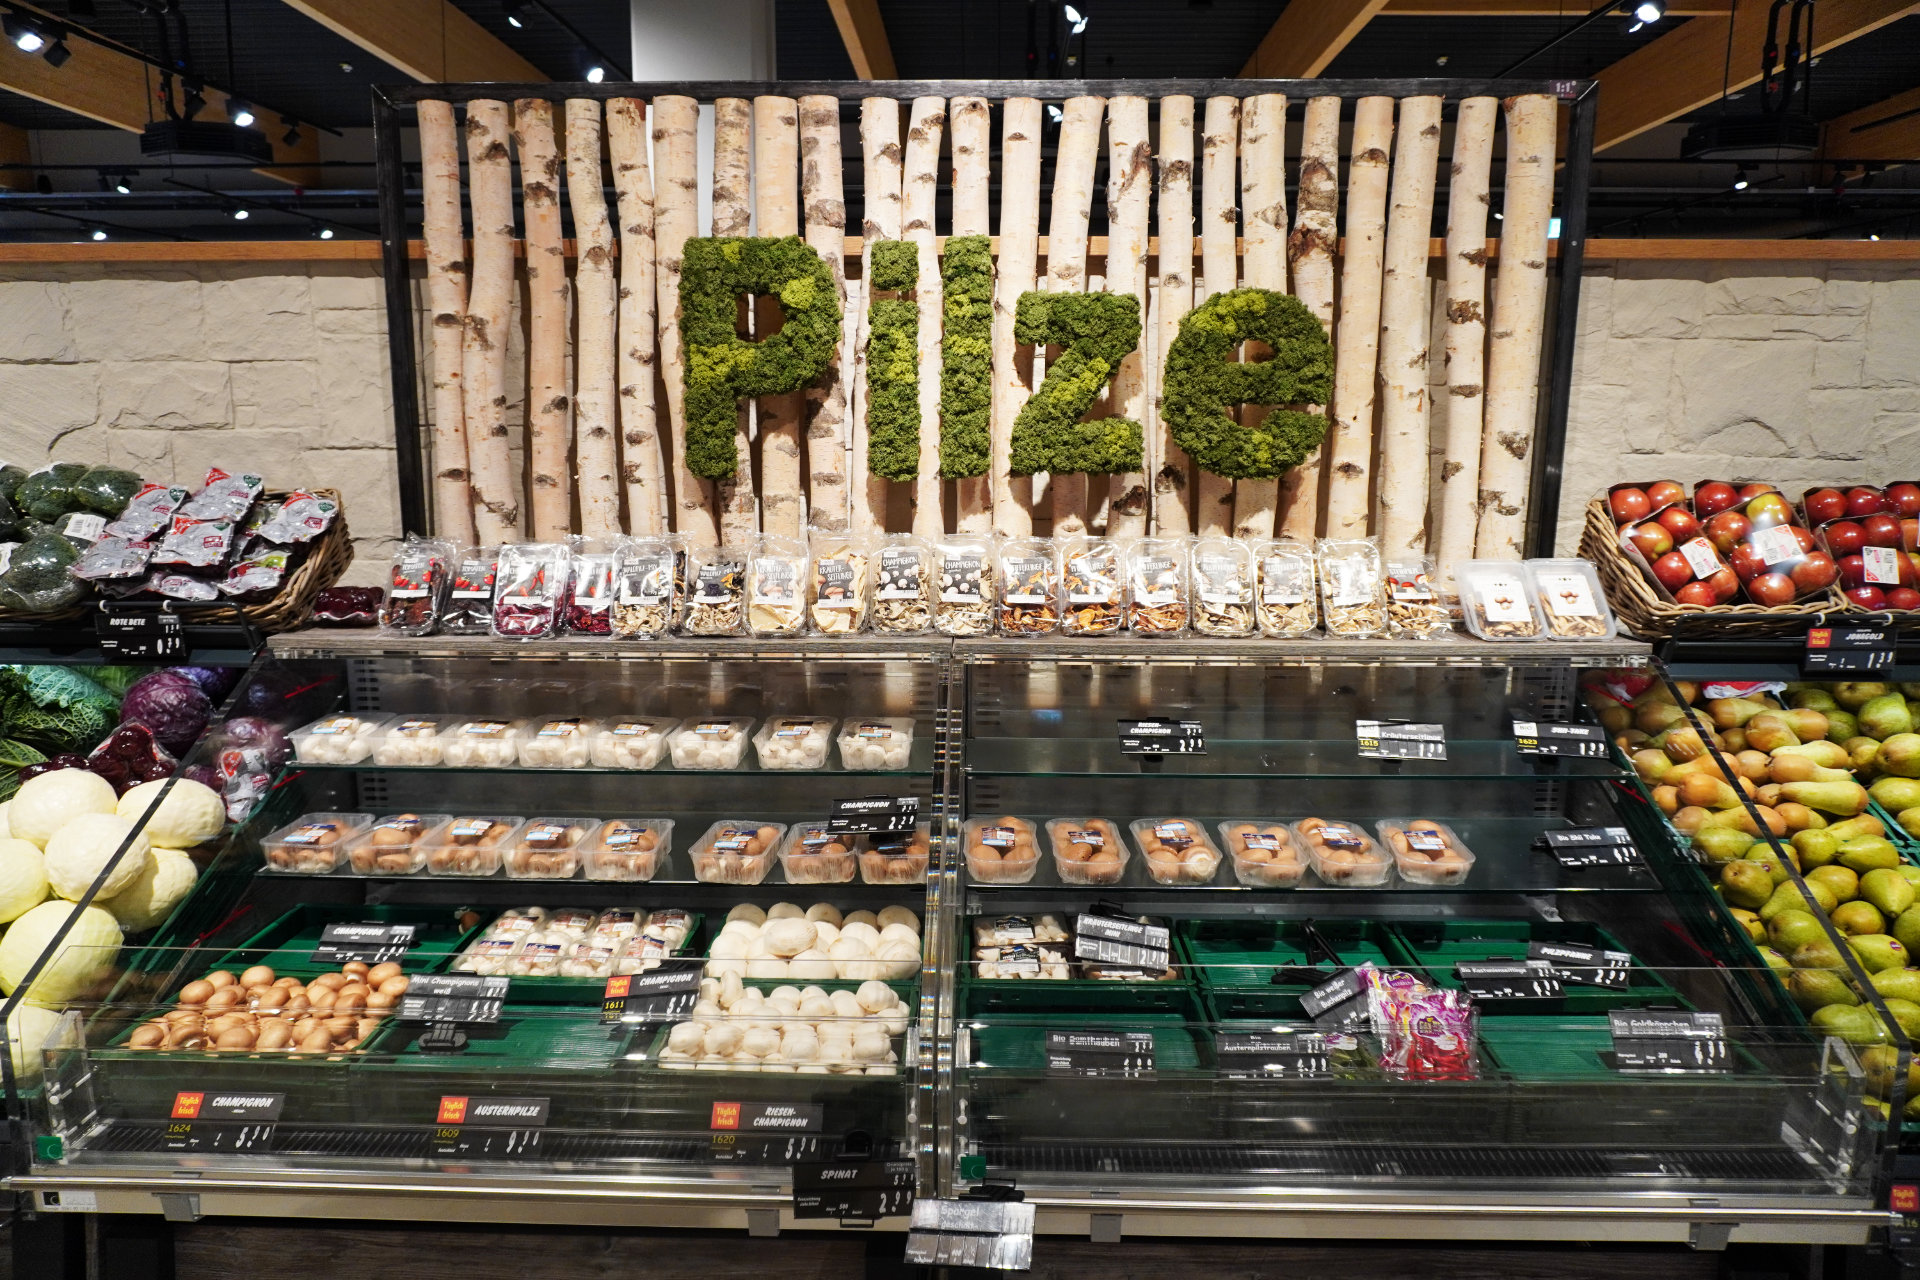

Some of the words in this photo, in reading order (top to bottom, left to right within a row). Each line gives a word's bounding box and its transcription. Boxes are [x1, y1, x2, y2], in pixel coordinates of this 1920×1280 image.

[679, 234, 1334, 482] Pilze
[883, 556, 917, 566] CHAMPIGNON
[945, 561, 980, 569] CHAMPIGNON
[1845, 633, 1884, 641] JONAGOLD
[840, 801, 890, 809] CHAMPIGNON
[1083, 918, 1144, 934] KRÄUTERSEITLINGE
[333, 927, 385, 936] CHAMPIGNON
[1104, 929, 1121, 937] MINI
[412, 976, 429, 984] Mini
[431, 978, 479, 987] Champignons
[640, 974, 693, 986] CHAMPIGNON
[1313, 990, 1326, 999] Bio
[180, 1096, 199, 1106] Täglich
[212, 1097, 274, 1107] CHAMPIGNON
[444, 1101, 463, 1111] Täglich
[178, 1106, 194, 1114] frisch
[443, 1111, 460, 1119] frisch
[474, 1105, 540, 1117] AUSTERNPILZE
[717, 1107, 736, 1117] Täglich
[765, 1107, 796, 1116] RIESEN-
[717, 1117, 734, 1125] frisch
[753, 1117, 808, 1127] CHAMPIGNON
[168, 1124, 191, 1132] 1624
[436, 1129, 459, 1138] 1609
[712, 1135, 735, 1144] 1620
[820, 1169, 858, 1180] SPINAT
[878, 1190, 912, 1214] 2.99
[941, 1205, 980, 1219] Spargel
